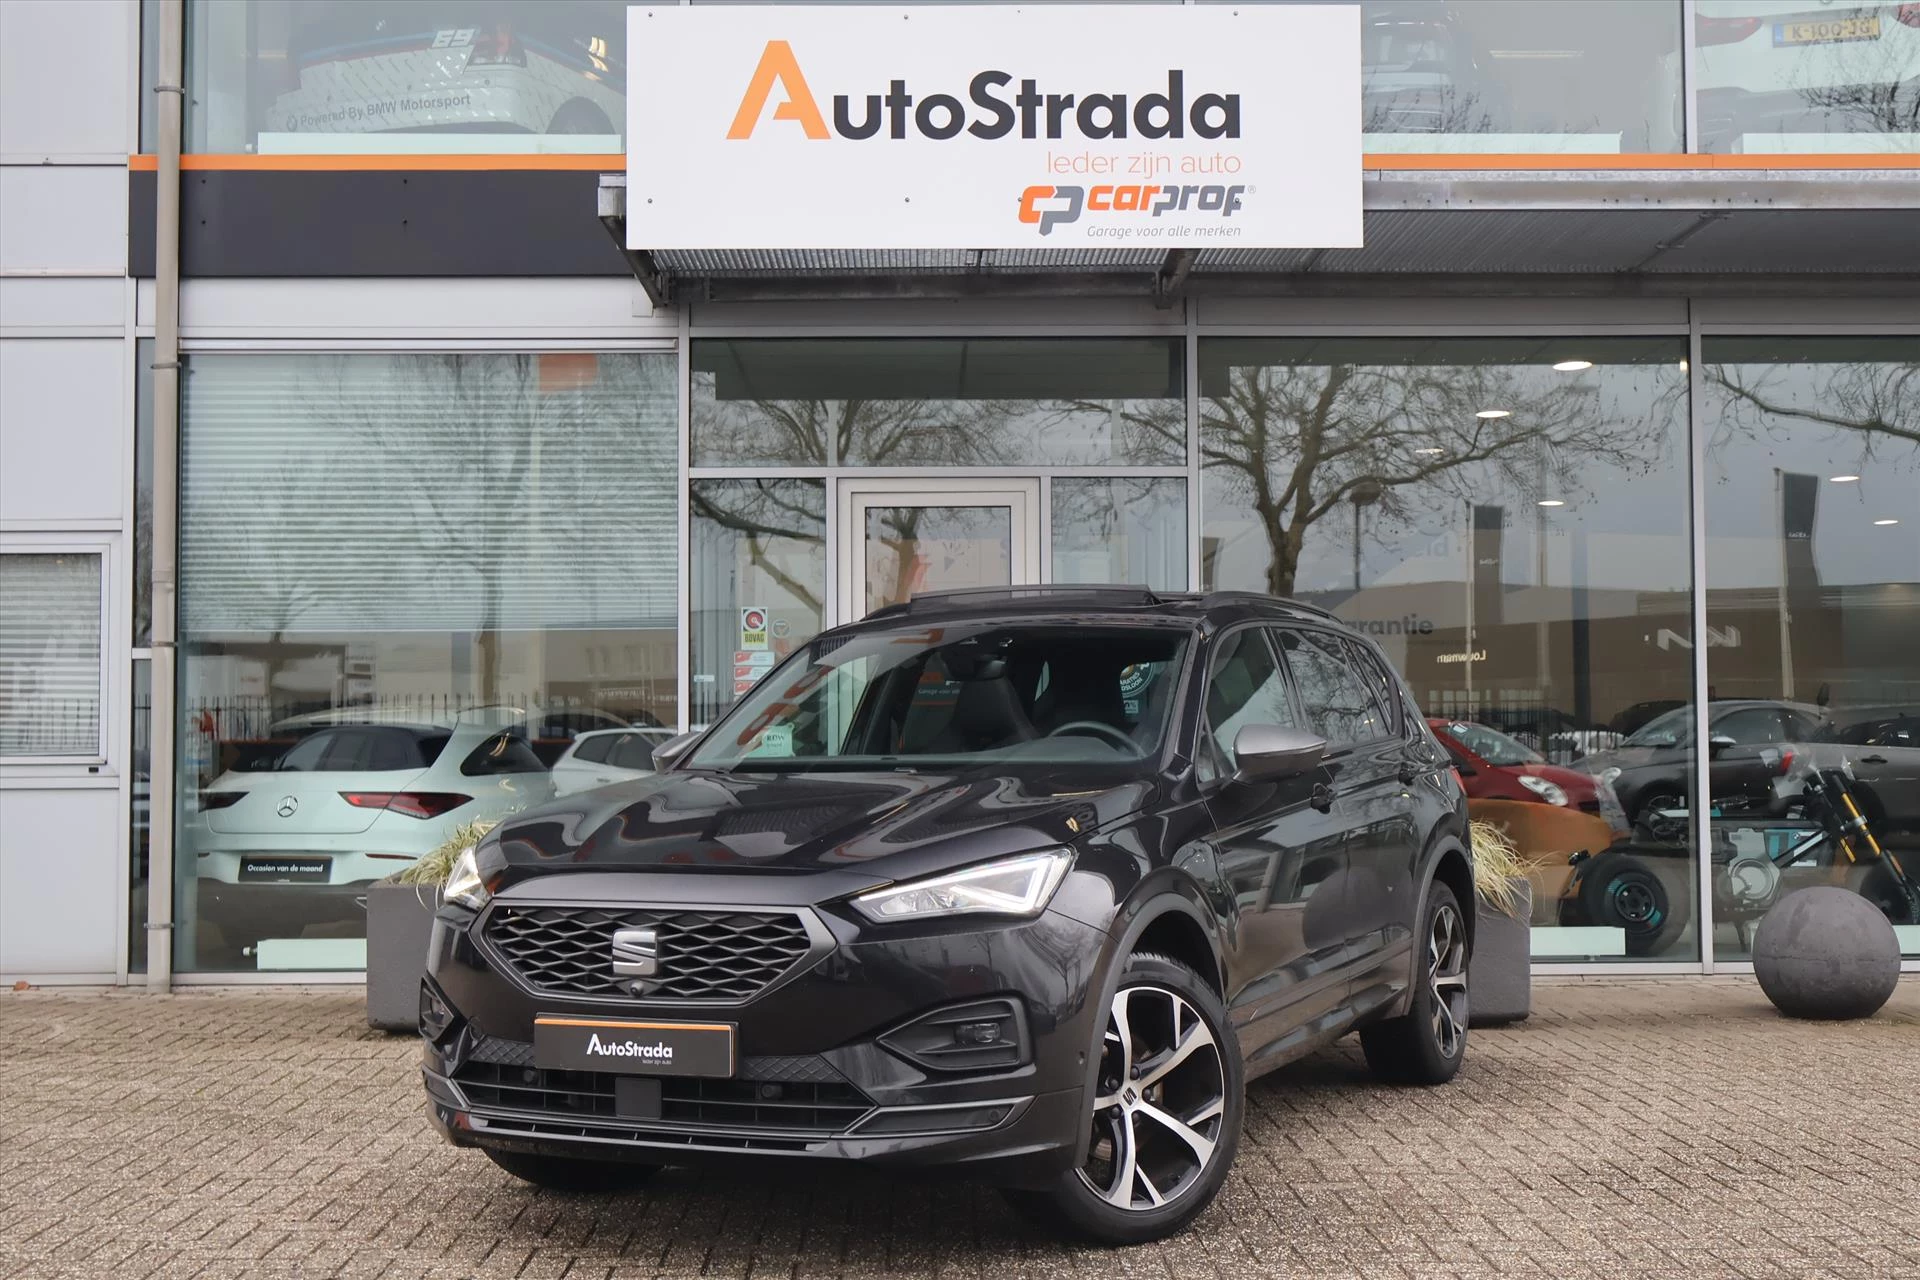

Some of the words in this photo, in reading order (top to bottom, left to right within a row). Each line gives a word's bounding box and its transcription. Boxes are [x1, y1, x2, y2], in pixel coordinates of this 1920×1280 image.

[726, 40, 1241, 140] AutoStrada
[300, 107, 346, 127] Powered
[349, 106, 364, 121] By
[367, 101, 397, 116] BMW
[400, 93, 472, 113] Motorsport
[1048, 151, 1119, 174] Ieder
[1128, 151, 1171, 179] zijn
[1181, 152, 1241, 174] auto
[1087, 185, 1246, 217] carprof
[1087, 225, 1132, 240] Garage
[1136, 227, 1164, 237] voor
[1167, 225, 1191, 237] alle
[1194, 225, 1241, 237] merken
[744, 633, 765, 643] BOVAG
[247, 864, 276, 872] Occasion
[290, 864, 299, 872] de
[300, 864, 324, 873] maand
[586, 1033, 673, 1058] AutoStrada
